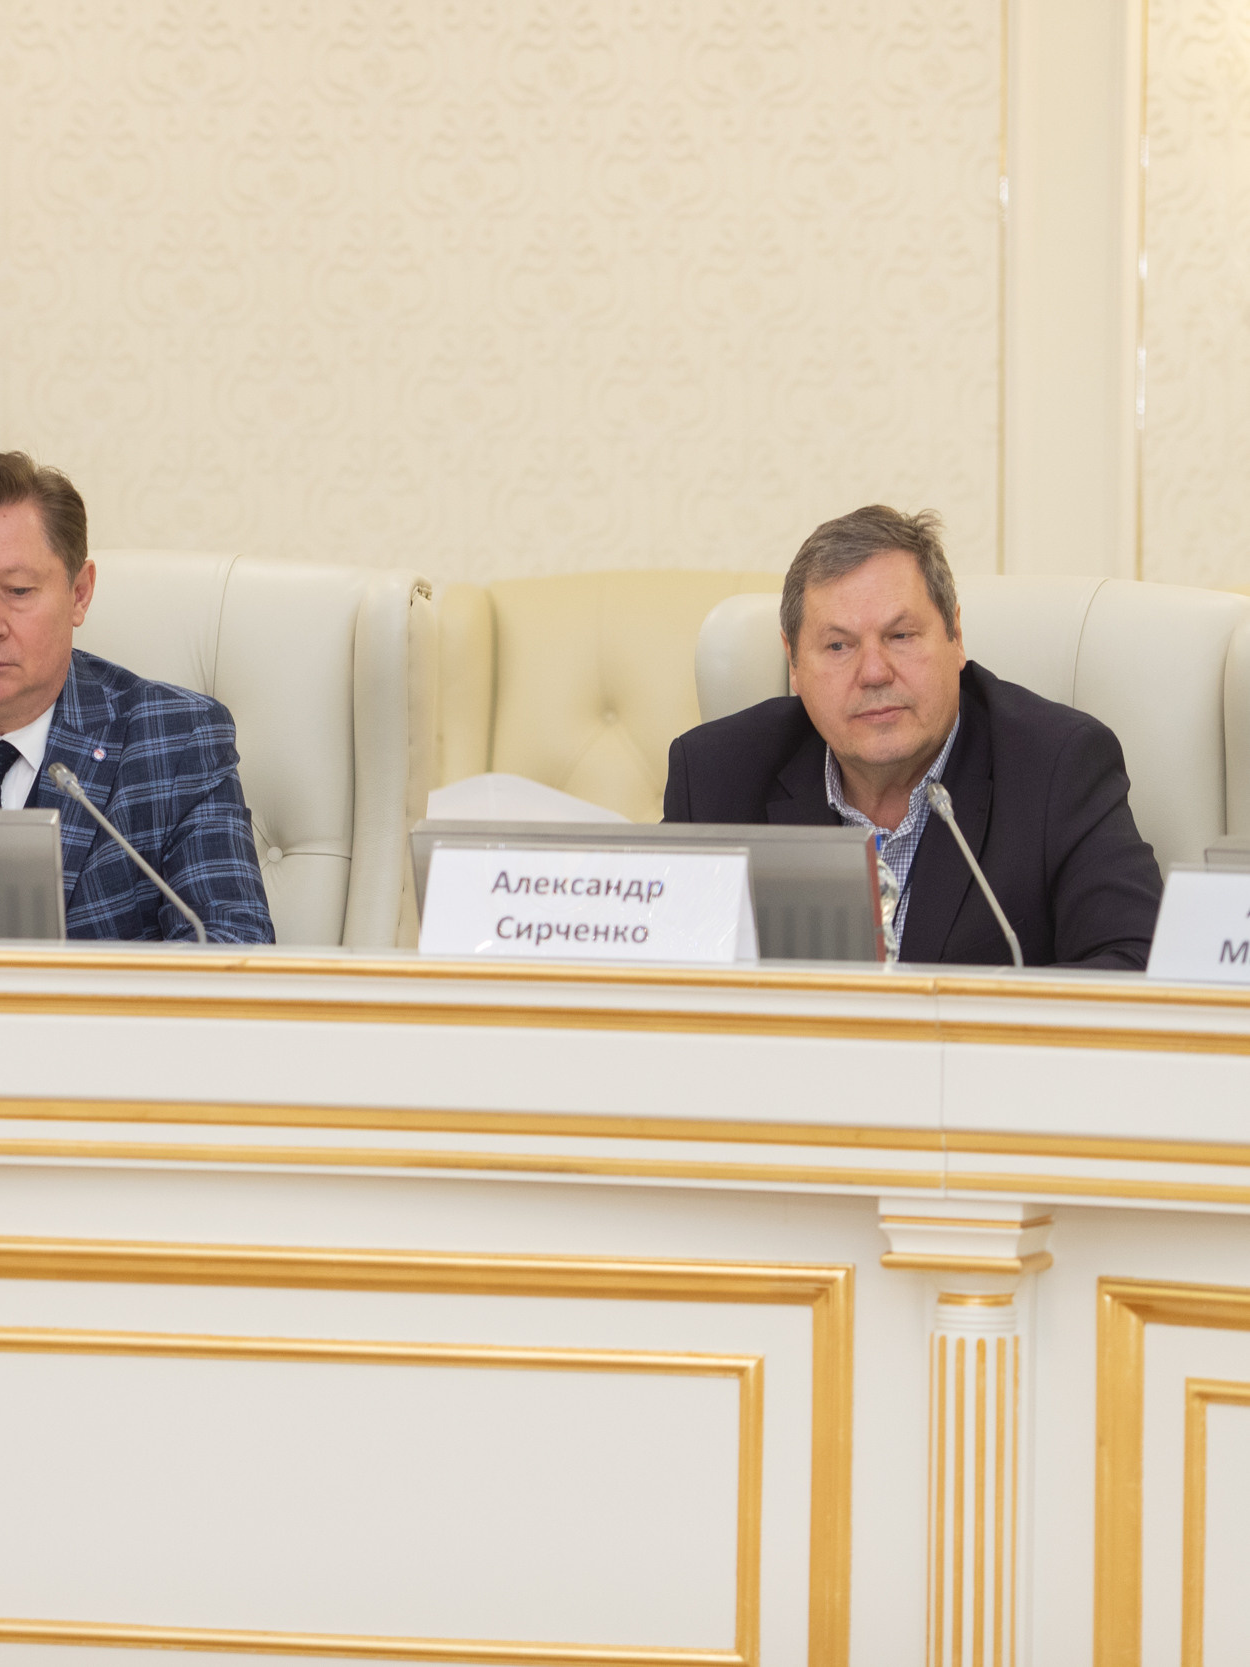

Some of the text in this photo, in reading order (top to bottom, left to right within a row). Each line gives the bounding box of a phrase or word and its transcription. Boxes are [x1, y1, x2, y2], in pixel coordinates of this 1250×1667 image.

[491, 870, 665, 904] Александр
[495, 915, 649, 946] Сирченко
[1219, 939, 1250, 965] М
